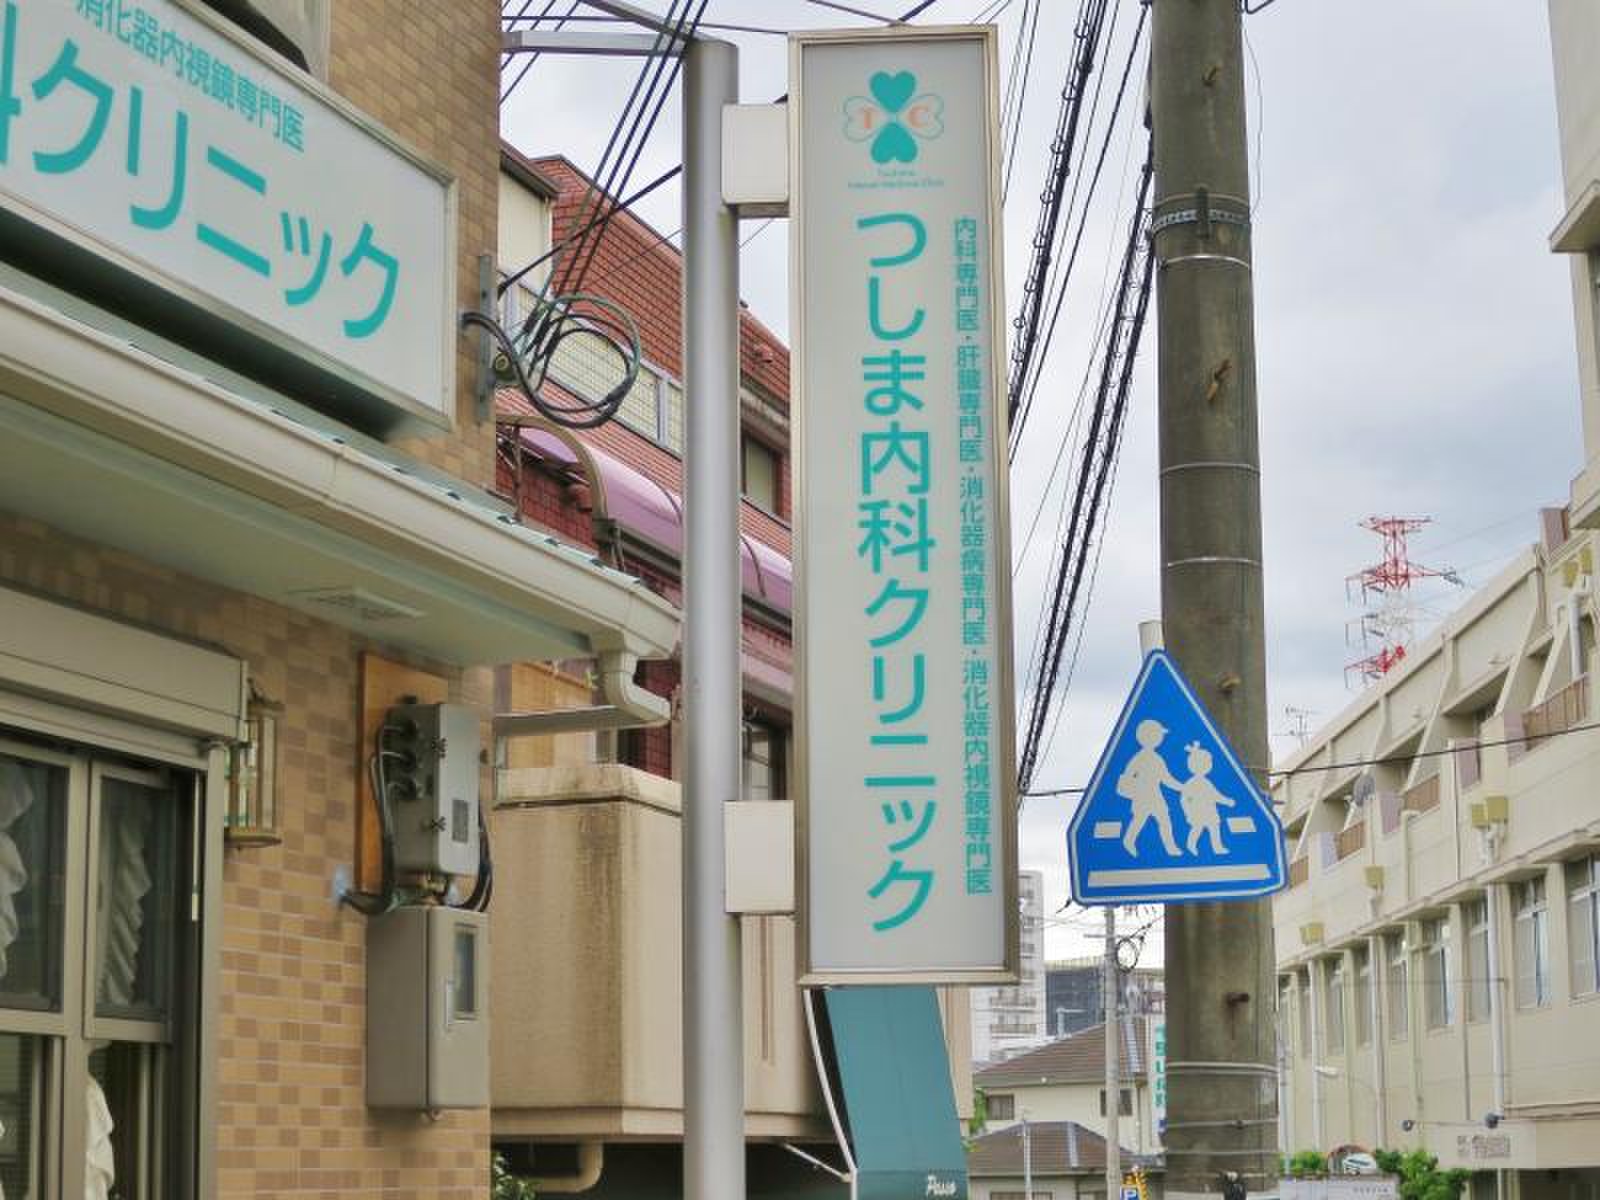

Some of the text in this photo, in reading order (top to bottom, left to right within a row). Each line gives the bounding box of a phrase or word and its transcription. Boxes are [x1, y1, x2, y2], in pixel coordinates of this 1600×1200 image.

[857, 212, 936, 932] つしま内科クリニック
